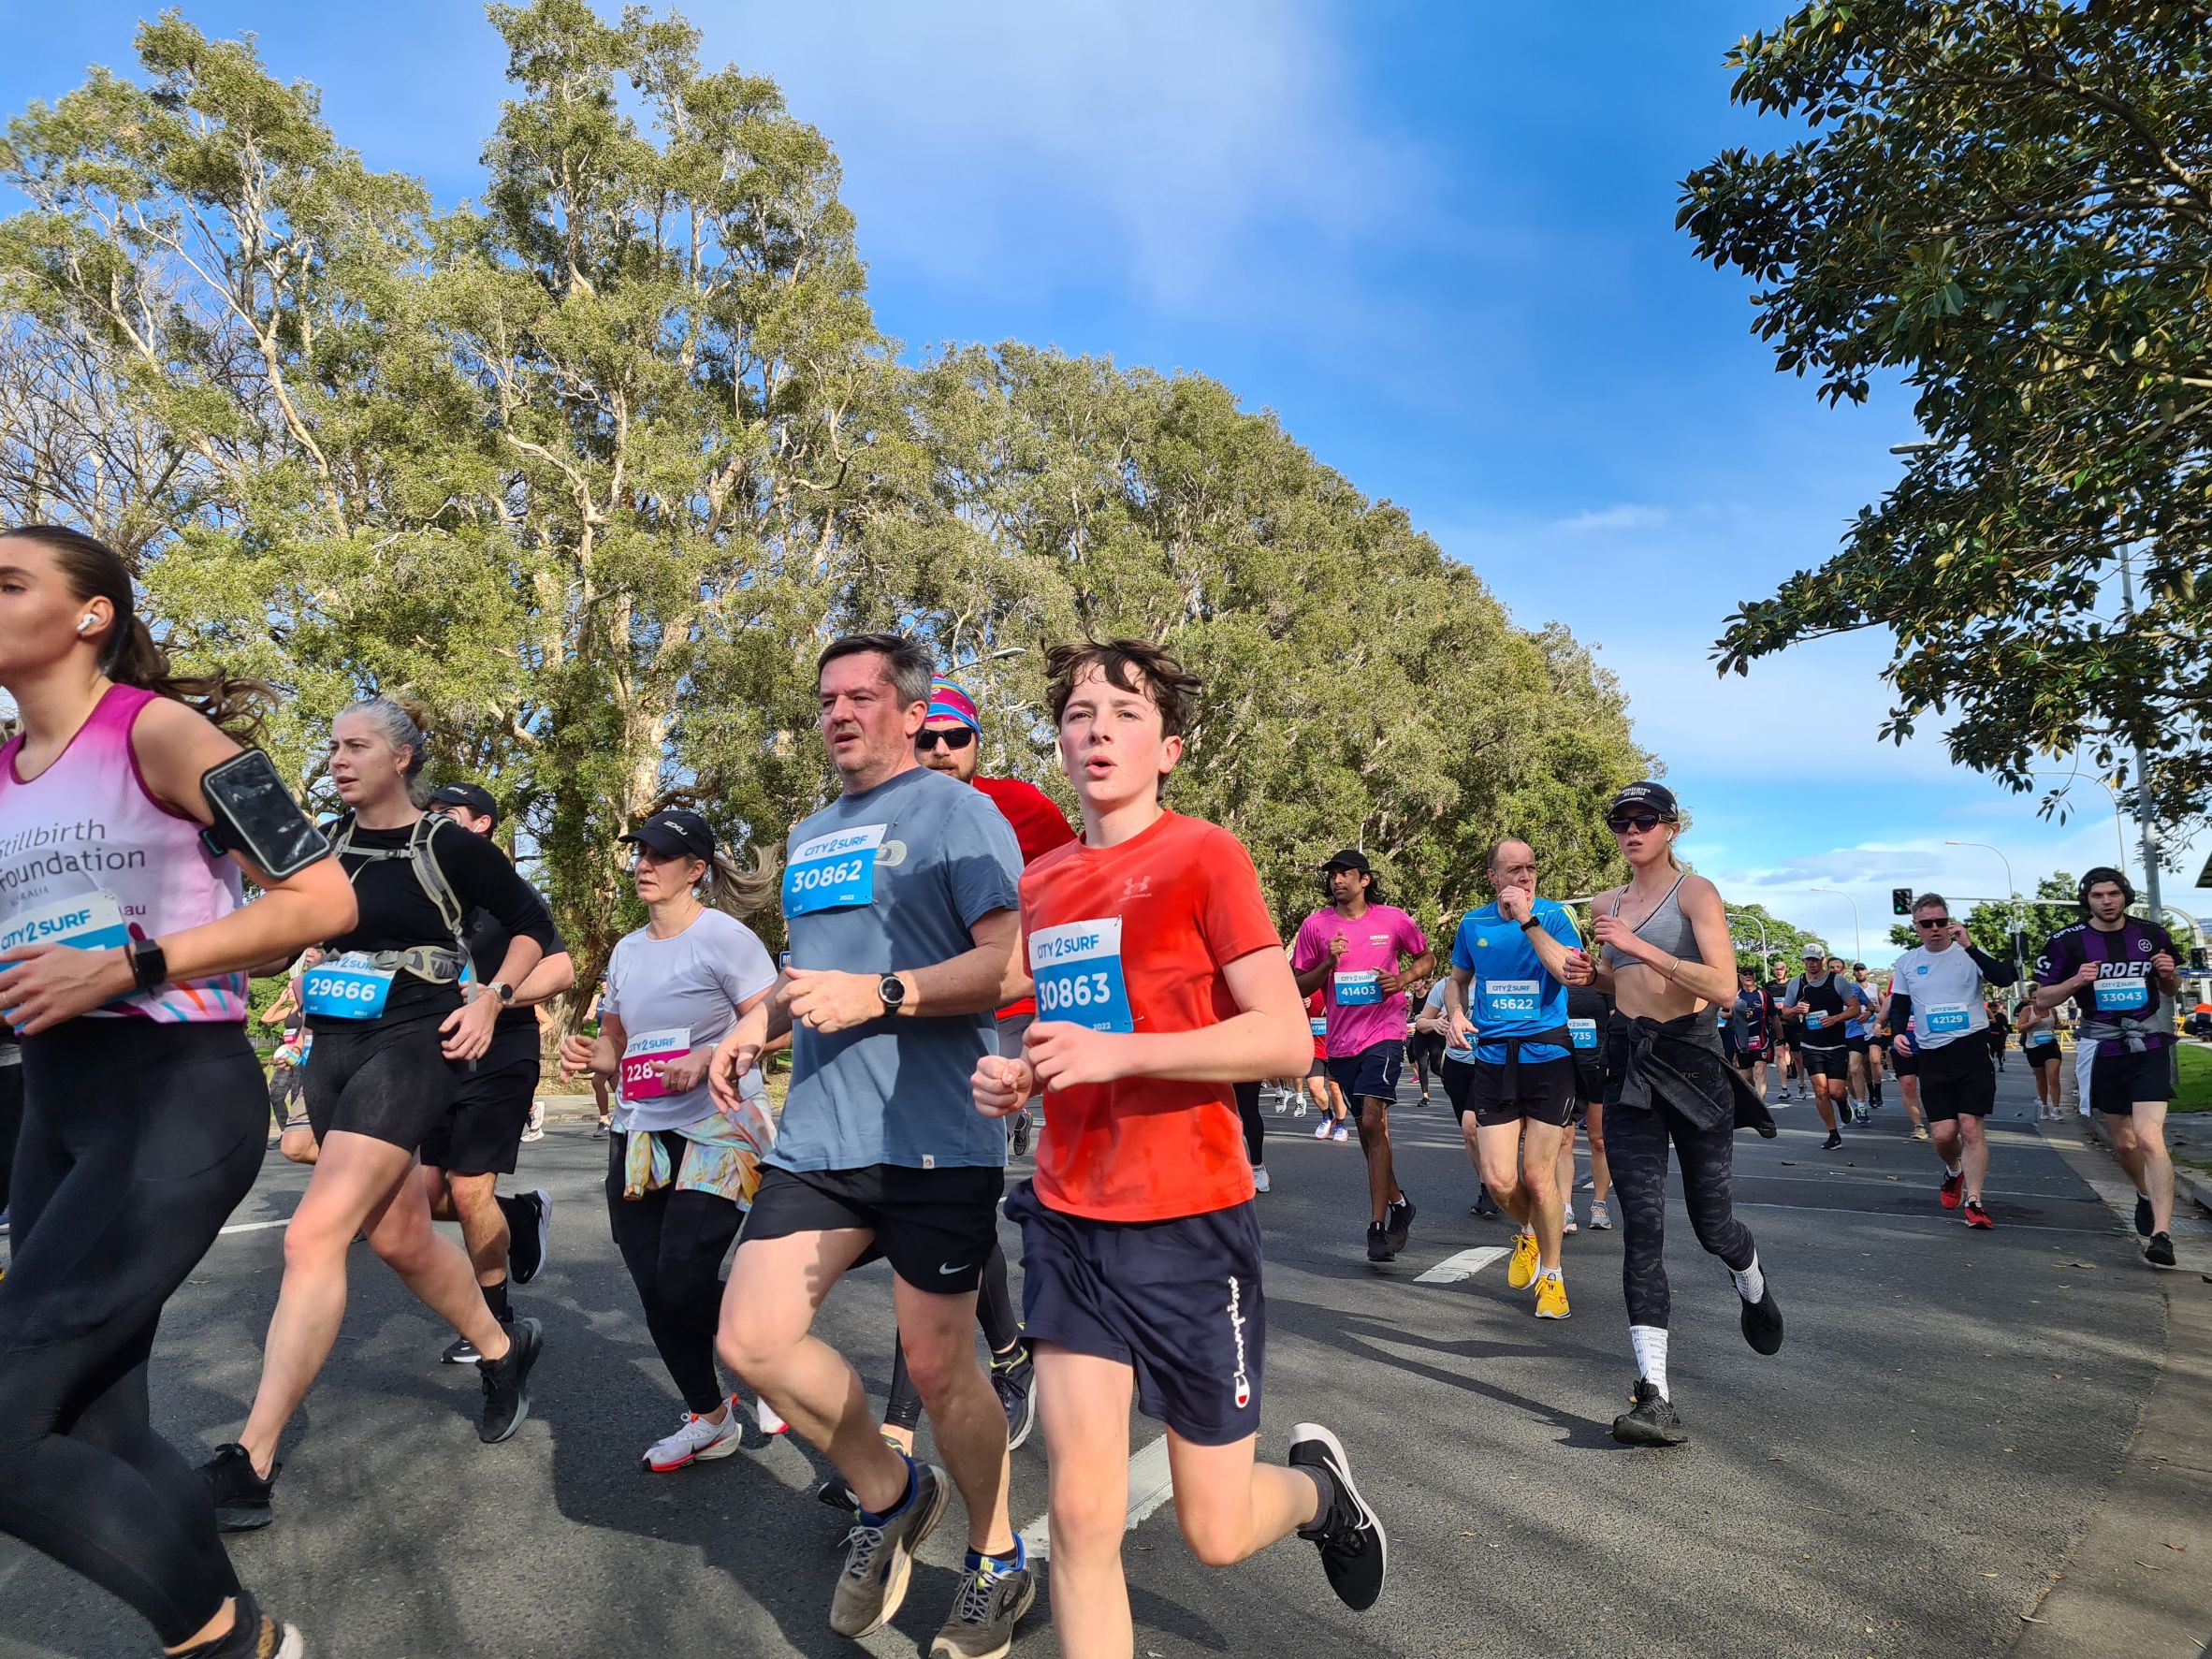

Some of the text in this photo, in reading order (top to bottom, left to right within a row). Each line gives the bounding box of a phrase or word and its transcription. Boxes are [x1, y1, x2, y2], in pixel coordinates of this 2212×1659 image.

[791, 860, 862, 893] 30862
[2053, 924, 2086, 939] OPTUS
[308, 978, 377, 1001] 29666
[1039, 972, 1111, 1011] 30863
[1341, 985, 1376, 997] 41403
[2101, 992, 2142, 1002] 33043
[1492, 998, 1534, 1010] 45622
[1932, 1014, 1963, 1025] 42129
[1093, 1022, 1111, 1030] 2022
[1569, 1031, 1592, 1041] 735
[627, 1059, 674, 1084] 228
